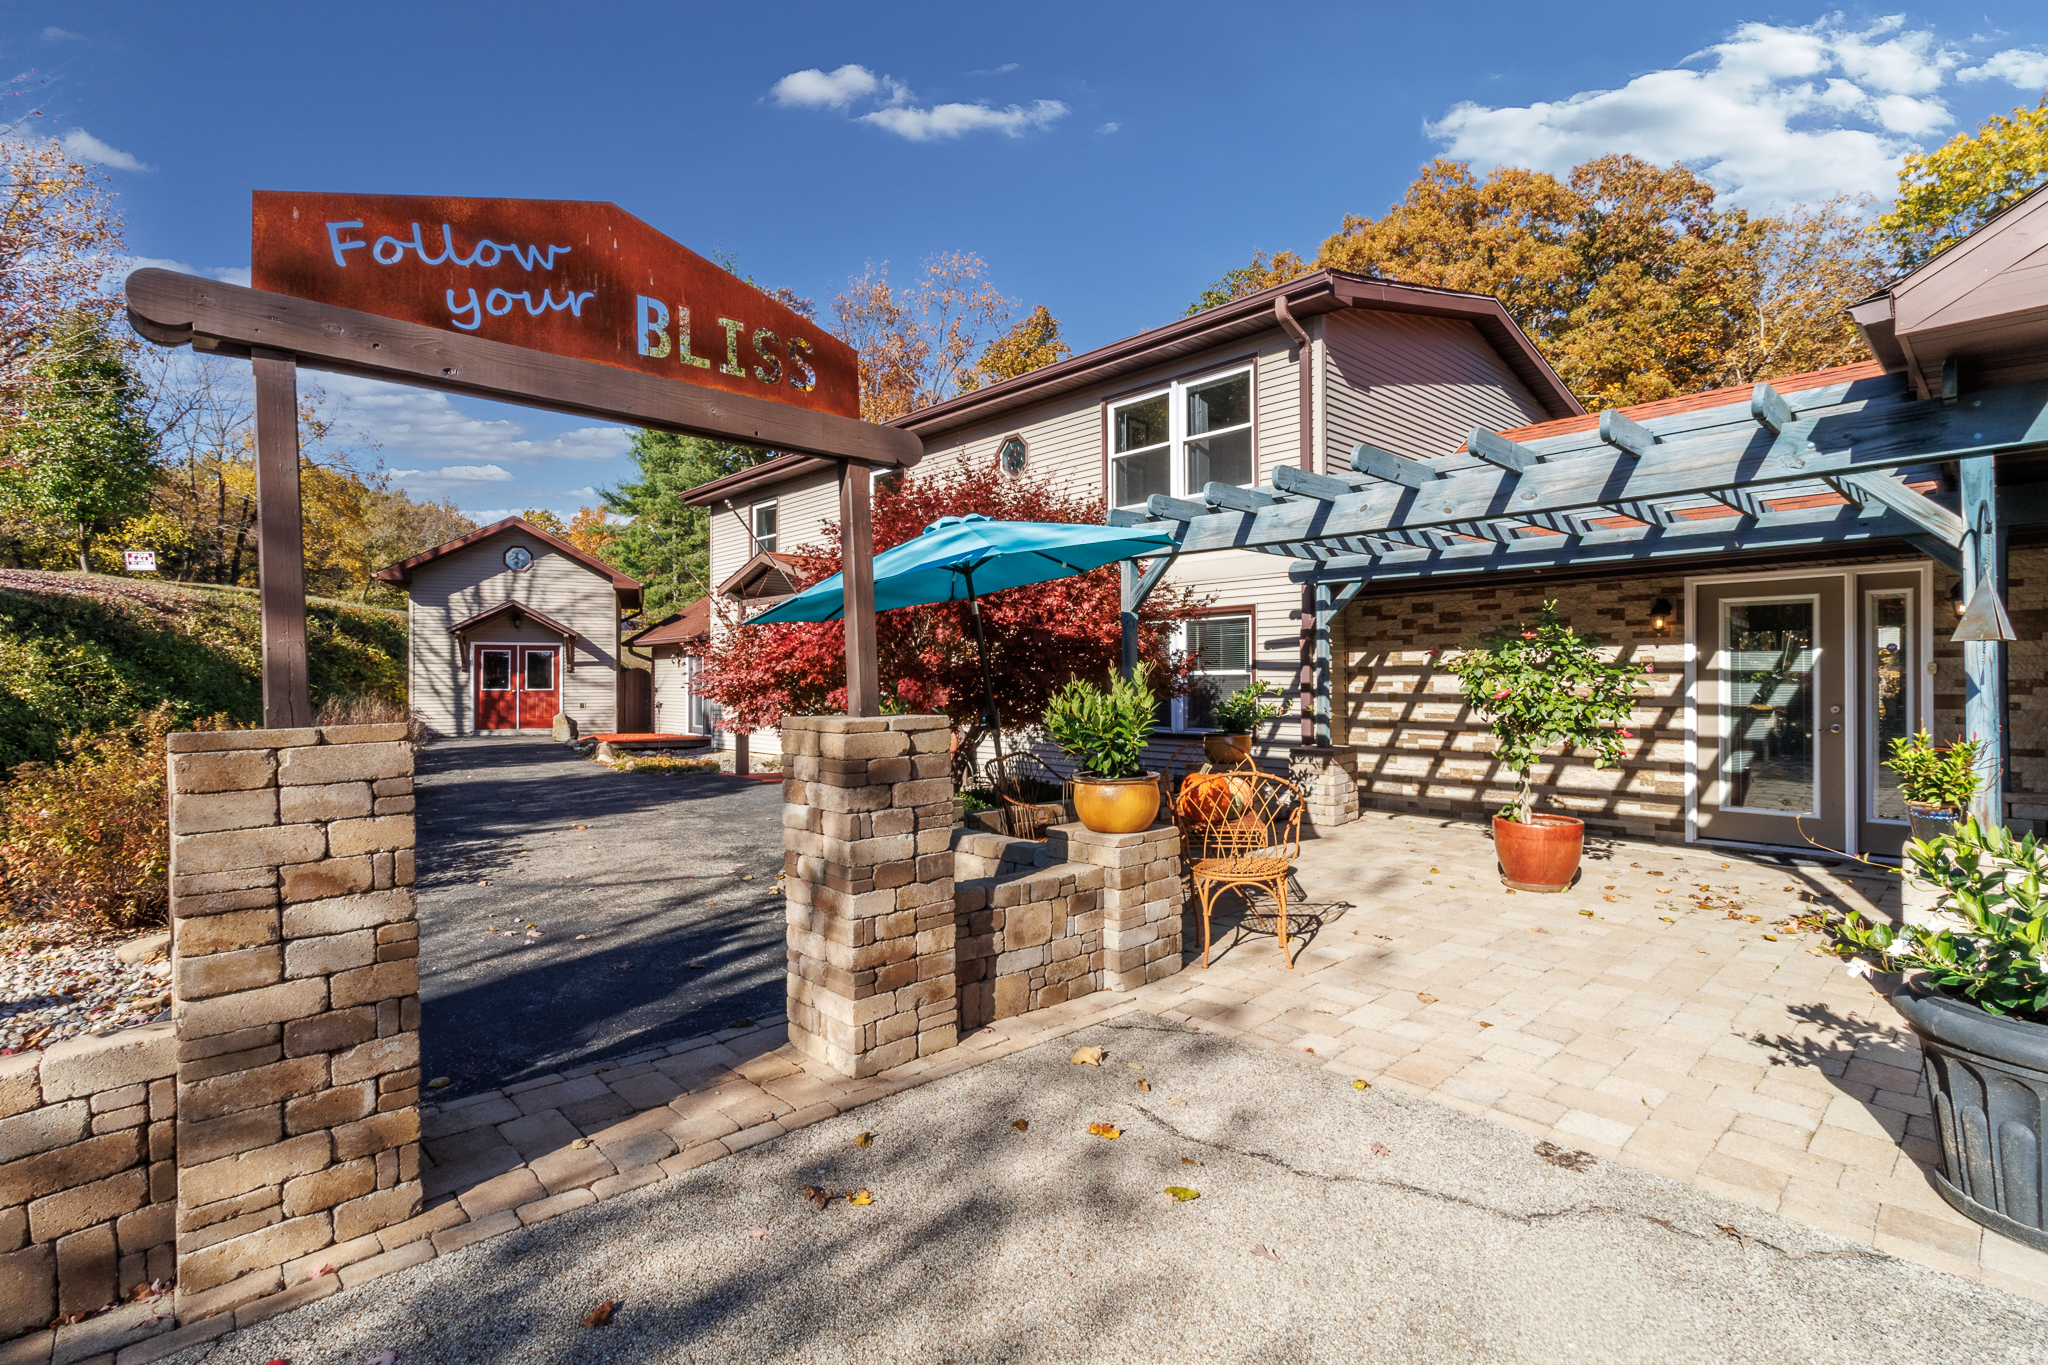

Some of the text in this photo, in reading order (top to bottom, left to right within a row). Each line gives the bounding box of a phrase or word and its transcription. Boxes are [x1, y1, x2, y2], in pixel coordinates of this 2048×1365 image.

[325, 220, 572, 272] Follow
[446, 287, 816, 393] your BLISS
